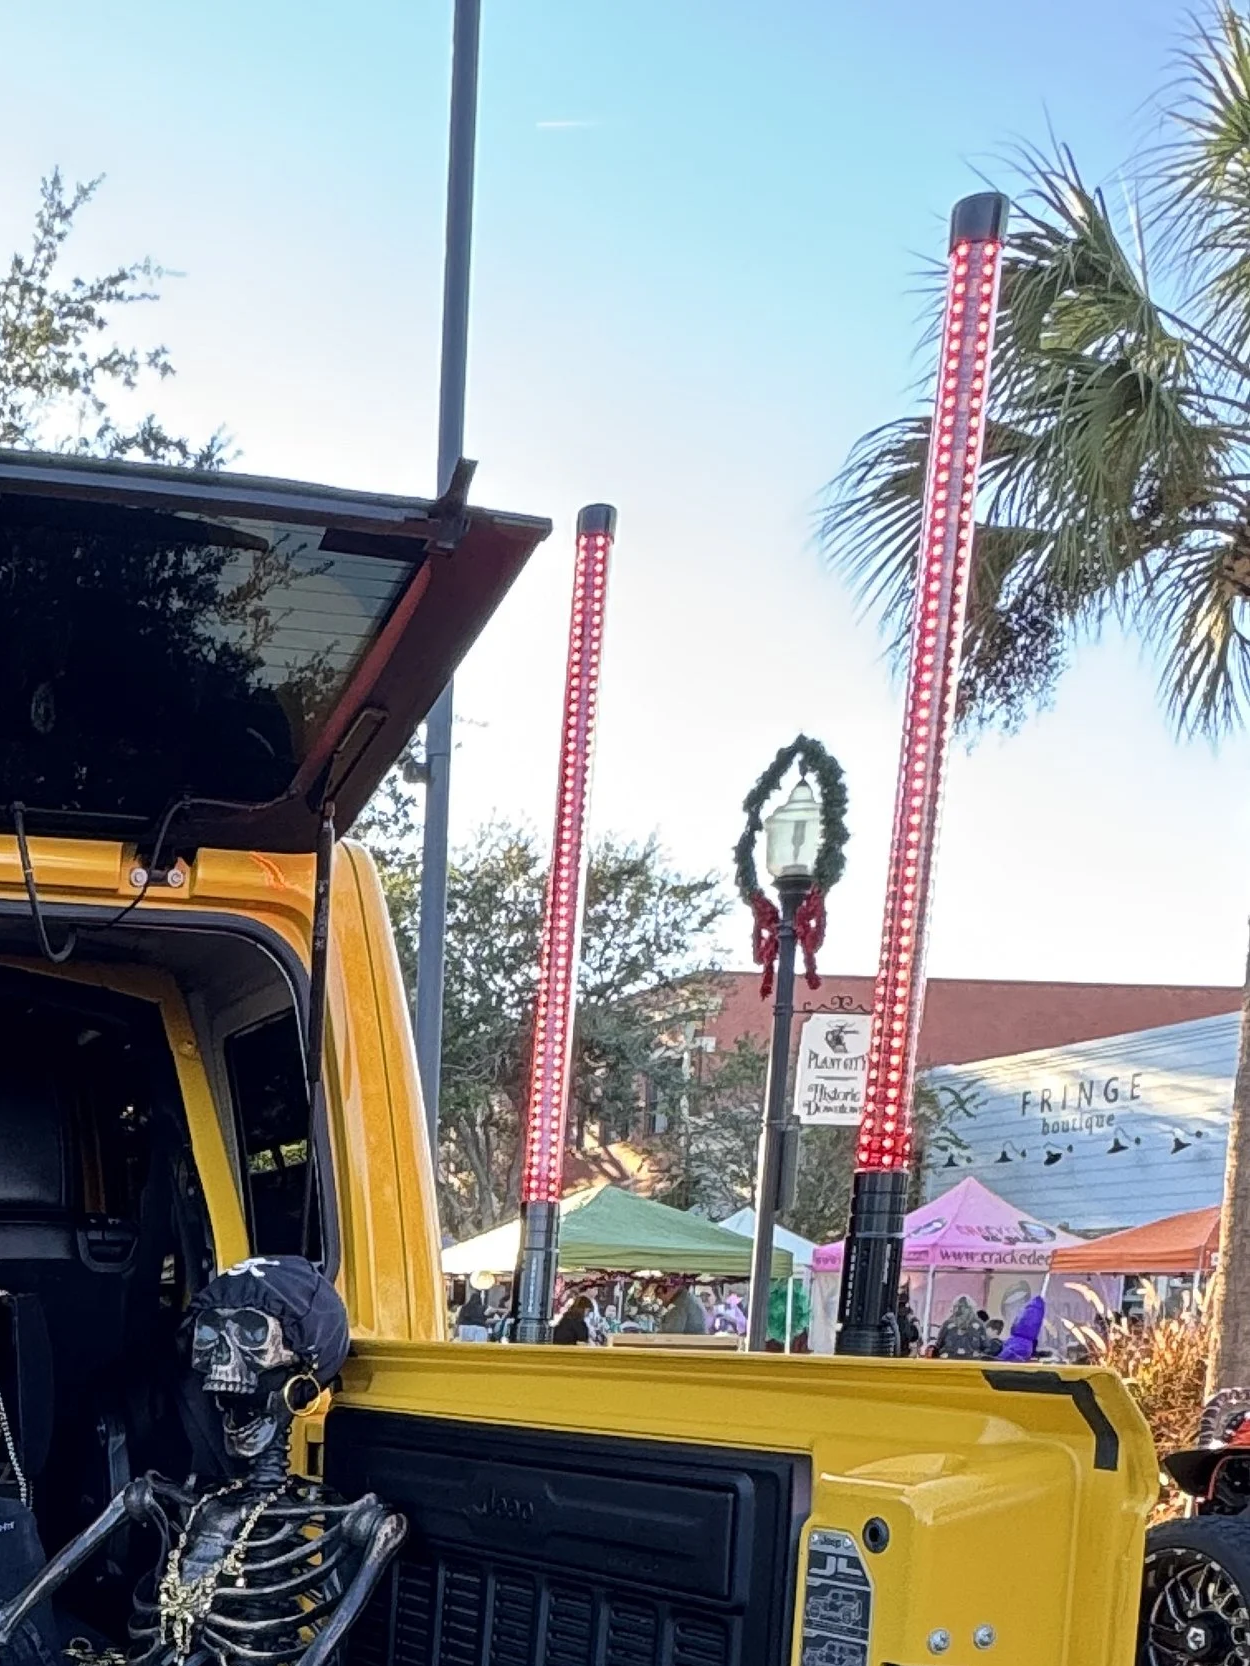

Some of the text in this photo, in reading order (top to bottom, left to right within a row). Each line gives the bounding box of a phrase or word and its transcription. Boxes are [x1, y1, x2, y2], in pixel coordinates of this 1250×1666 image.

[807, 1049, 842, 1070] PLANT
[807, 1084, 861, 1103] Historic
[1021, 1072, 1142, 1116] FRINGE
[1041, 1113, 1115, 1135] boutique
